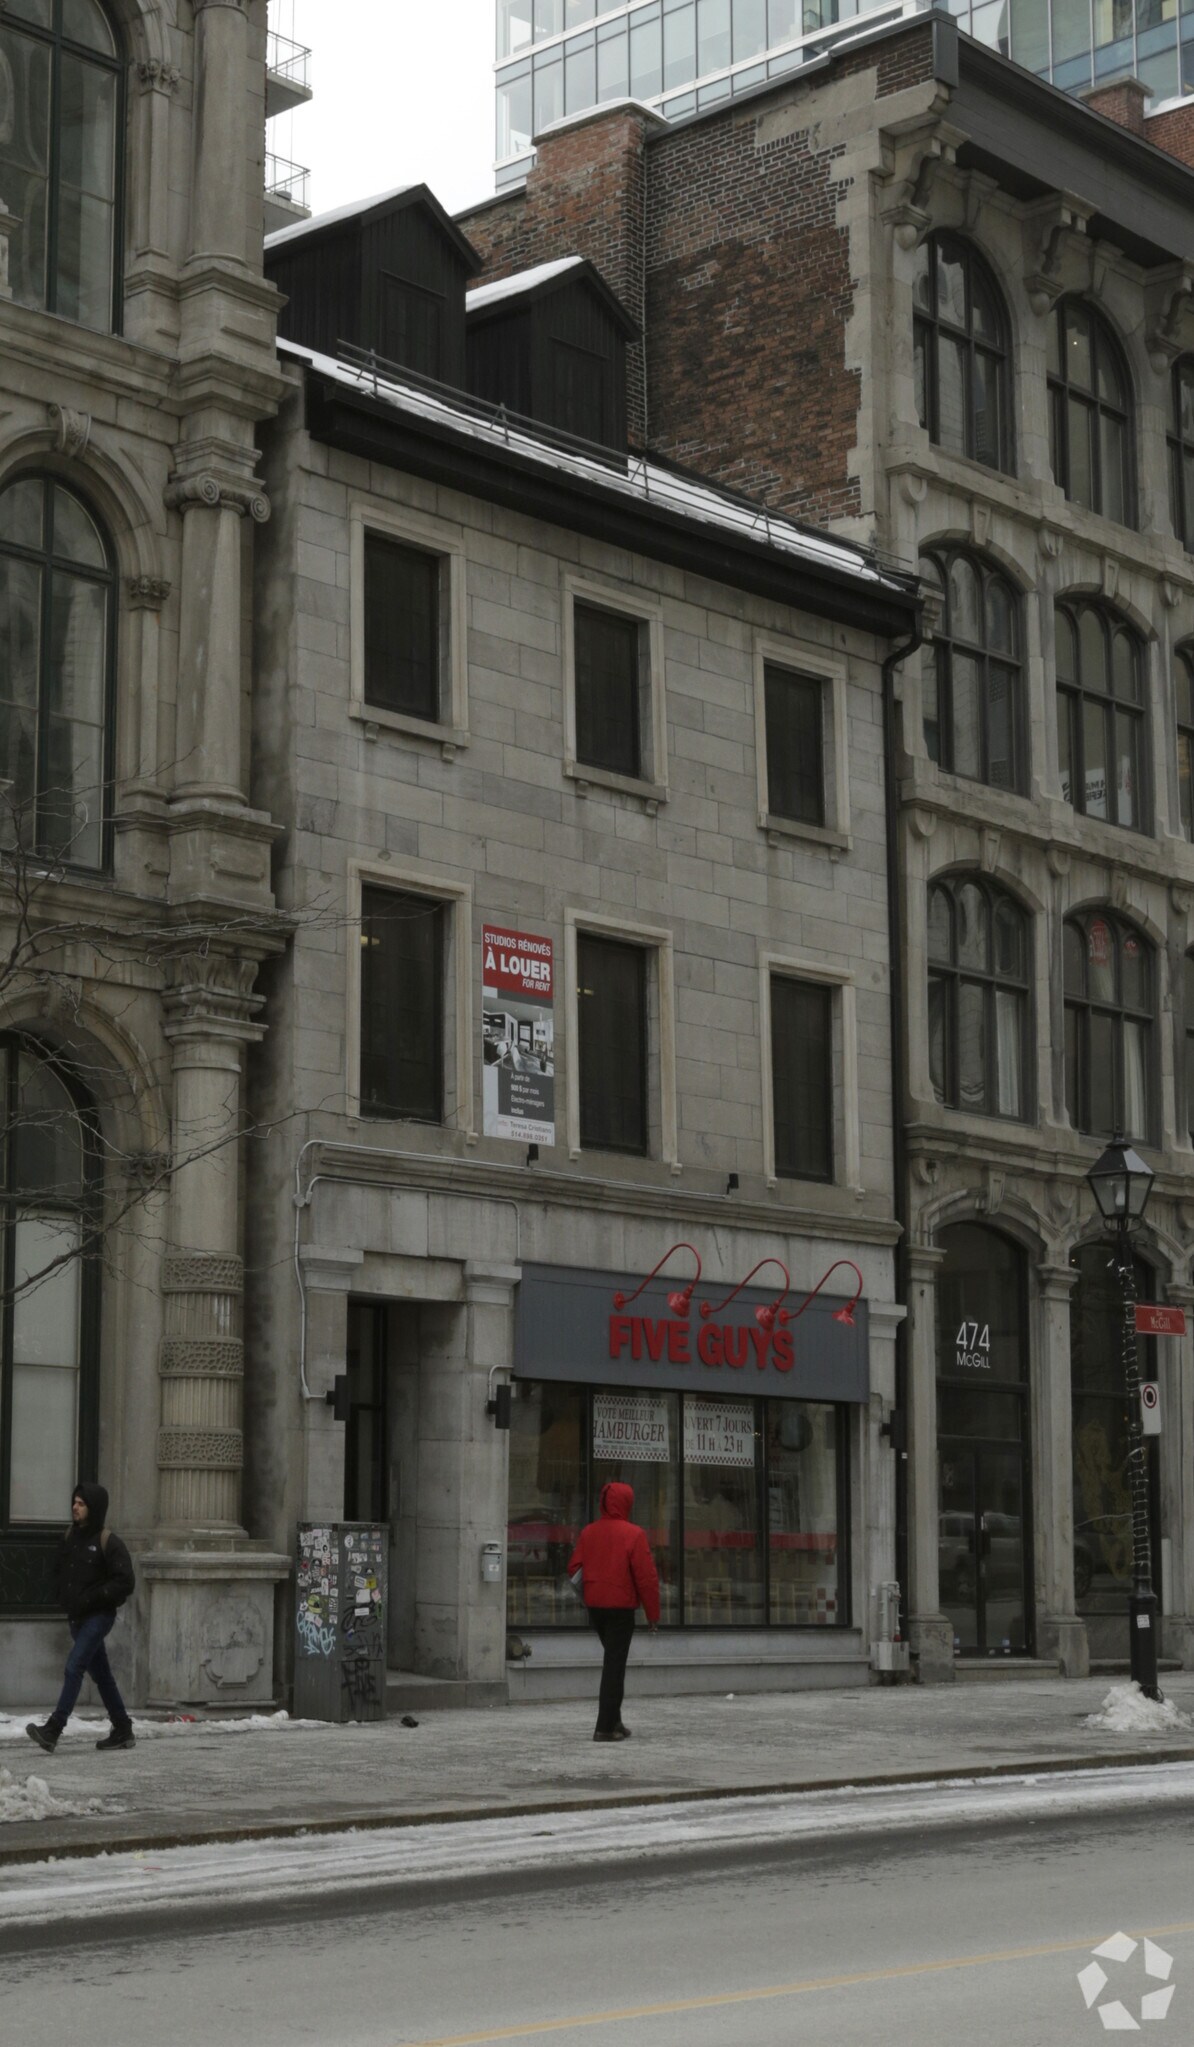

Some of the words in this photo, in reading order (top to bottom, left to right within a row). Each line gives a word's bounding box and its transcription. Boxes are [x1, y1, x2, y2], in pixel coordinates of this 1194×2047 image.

[484, 933, 517, 949] STUDIOS
[518, 938, 551, 956] RÉNOVÉS
[485, 946, 497, 970] À
[500, 955, 551, 982] LOUER
[522, 978, 534, 989] FOR
[535, 980, 550, 992] RENT
[510, 1121, 527, 1130] Teresa
[1150, 1316, 1171, 1329] McGill
[609, 1315, 691, 1363] FIVE
[698, 1323, 794, 1372] GUYS
[956, 1321, 990, 1352] 474
[618, 1408, 655, 1422] MEILLEUR
[684, 1416, 714, 1431] UVERT
[716, 1415, 721, 1432] 7
[723, 1416, 752, 1434] JOURS
[593, 1420, 665, 1442] HAMBURGER
[686, 1439, 694, 1450] DE
[697, 1433, 705, 1450] 11
[709, 1437, 715, 1451] H
[724, 1434, 735, 1453] 23
[737, 1439, 743, 1453] H
